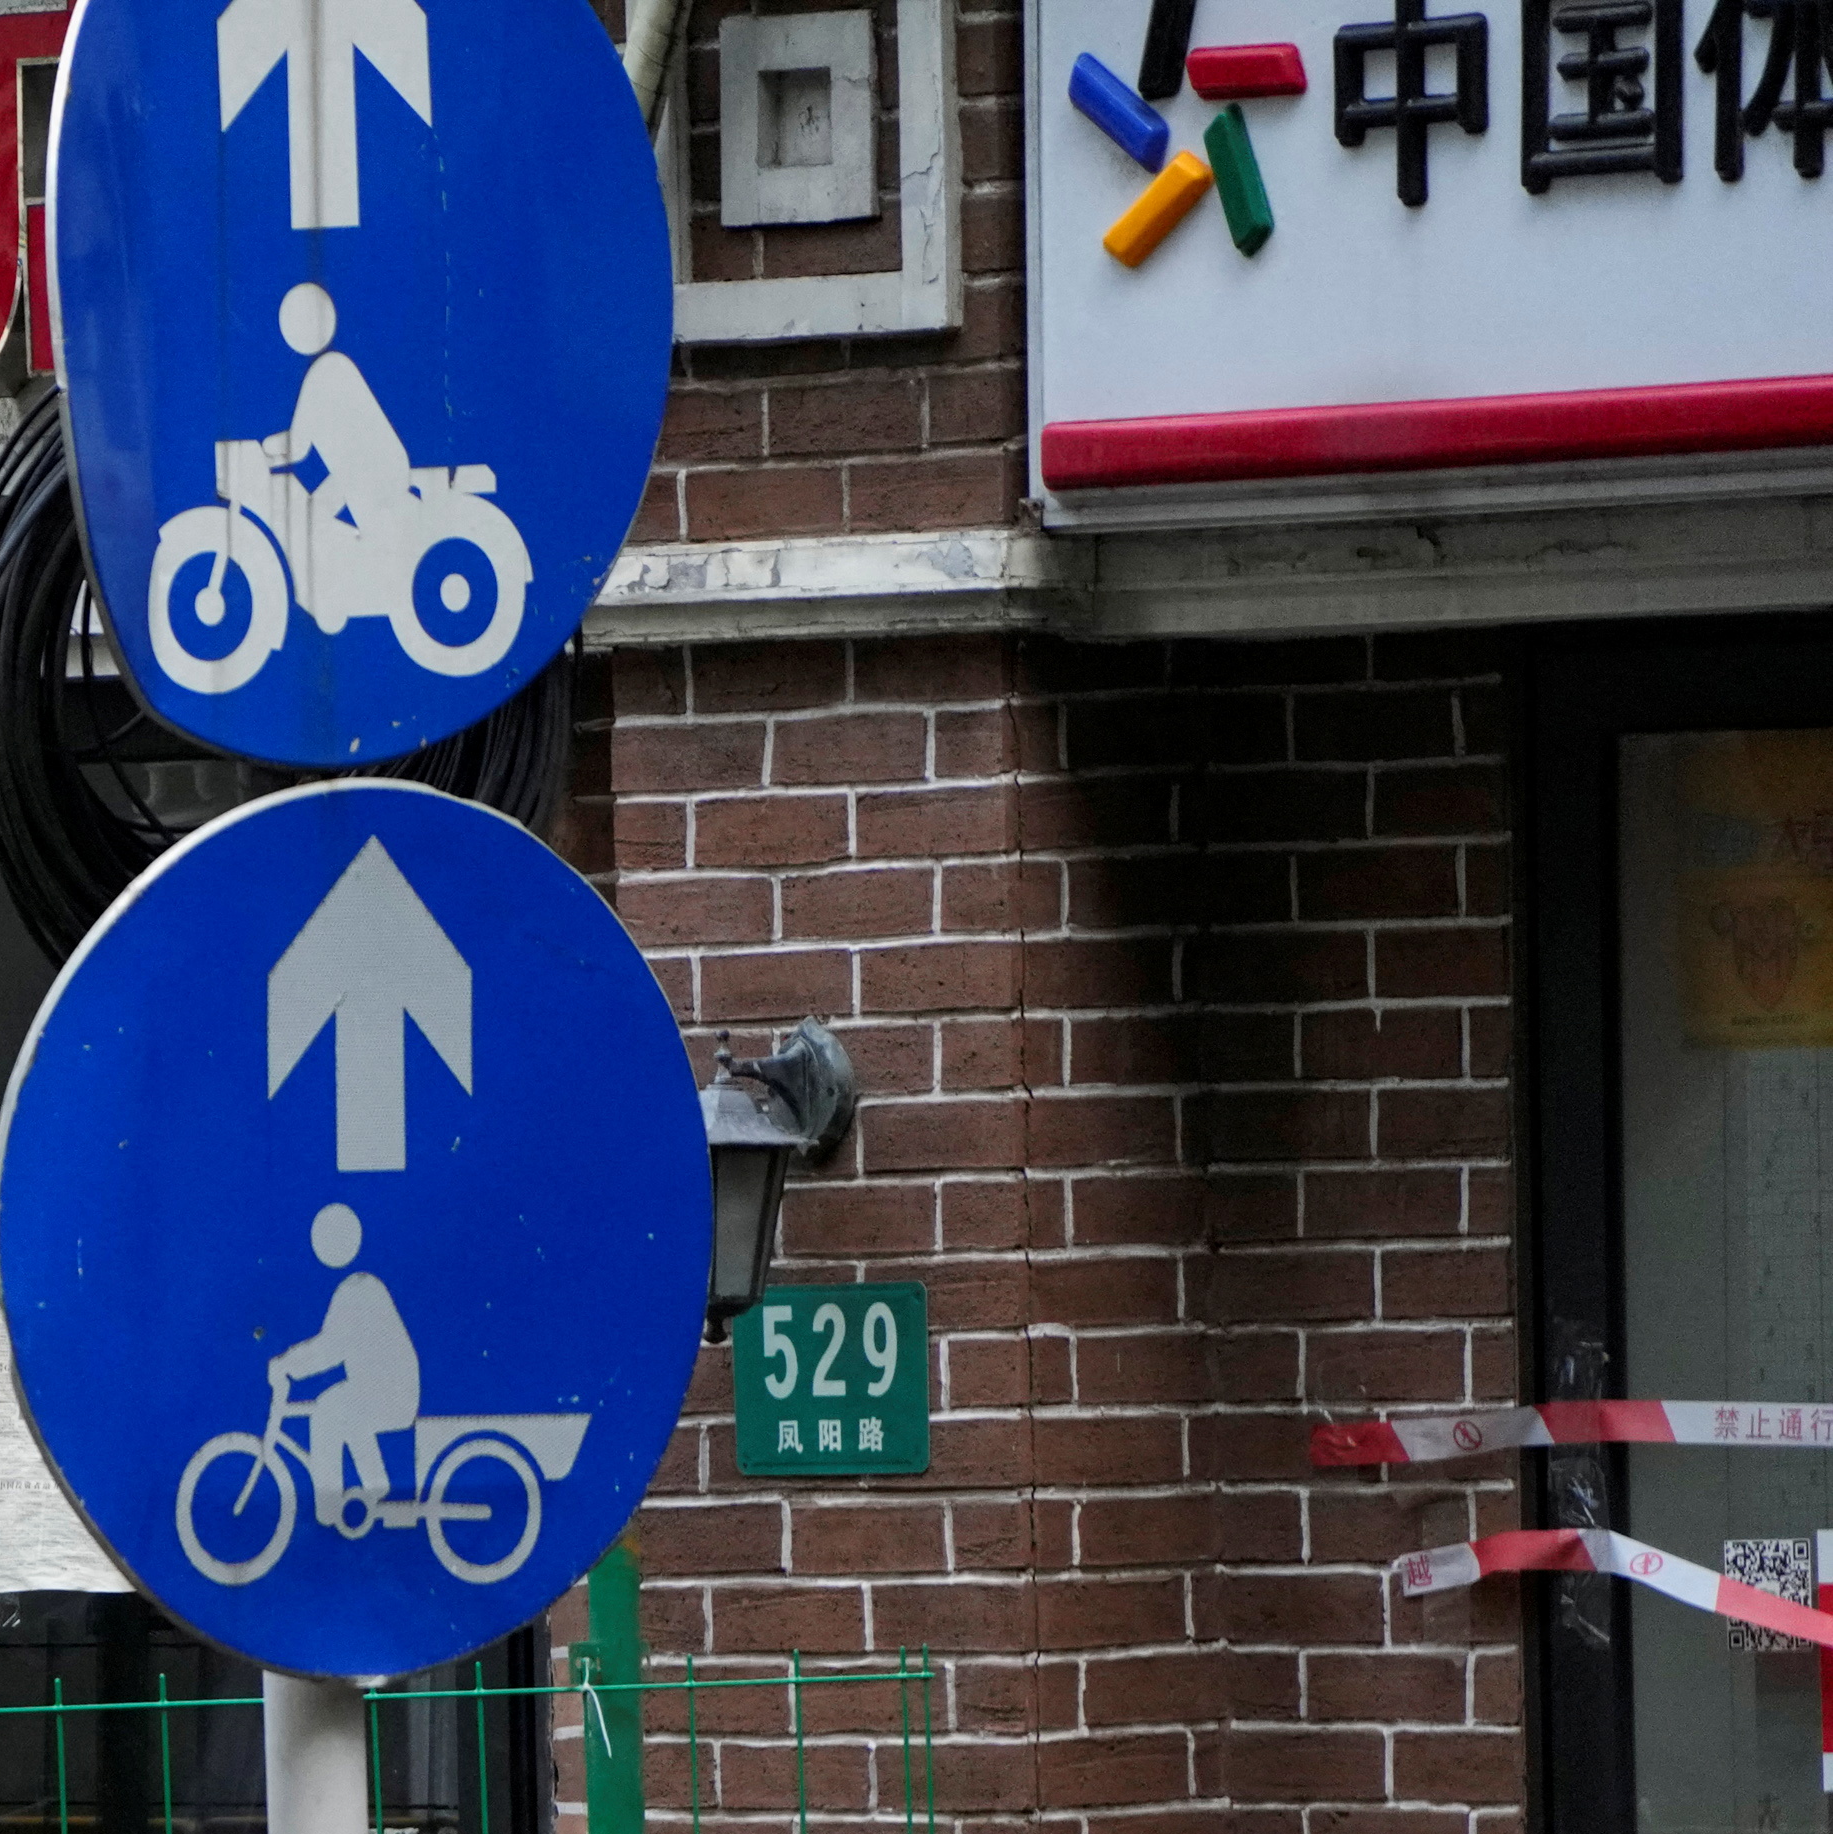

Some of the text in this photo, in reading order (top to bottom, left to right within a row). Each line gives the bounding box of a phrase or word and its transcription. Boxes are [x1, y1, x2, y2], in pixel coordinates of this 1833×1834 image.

[763, 1302, 898, 1399] 529
[777, 1416, 885, 1454] 凤阳路
[1714, 1406, 1833, 1441] 禁止通行
